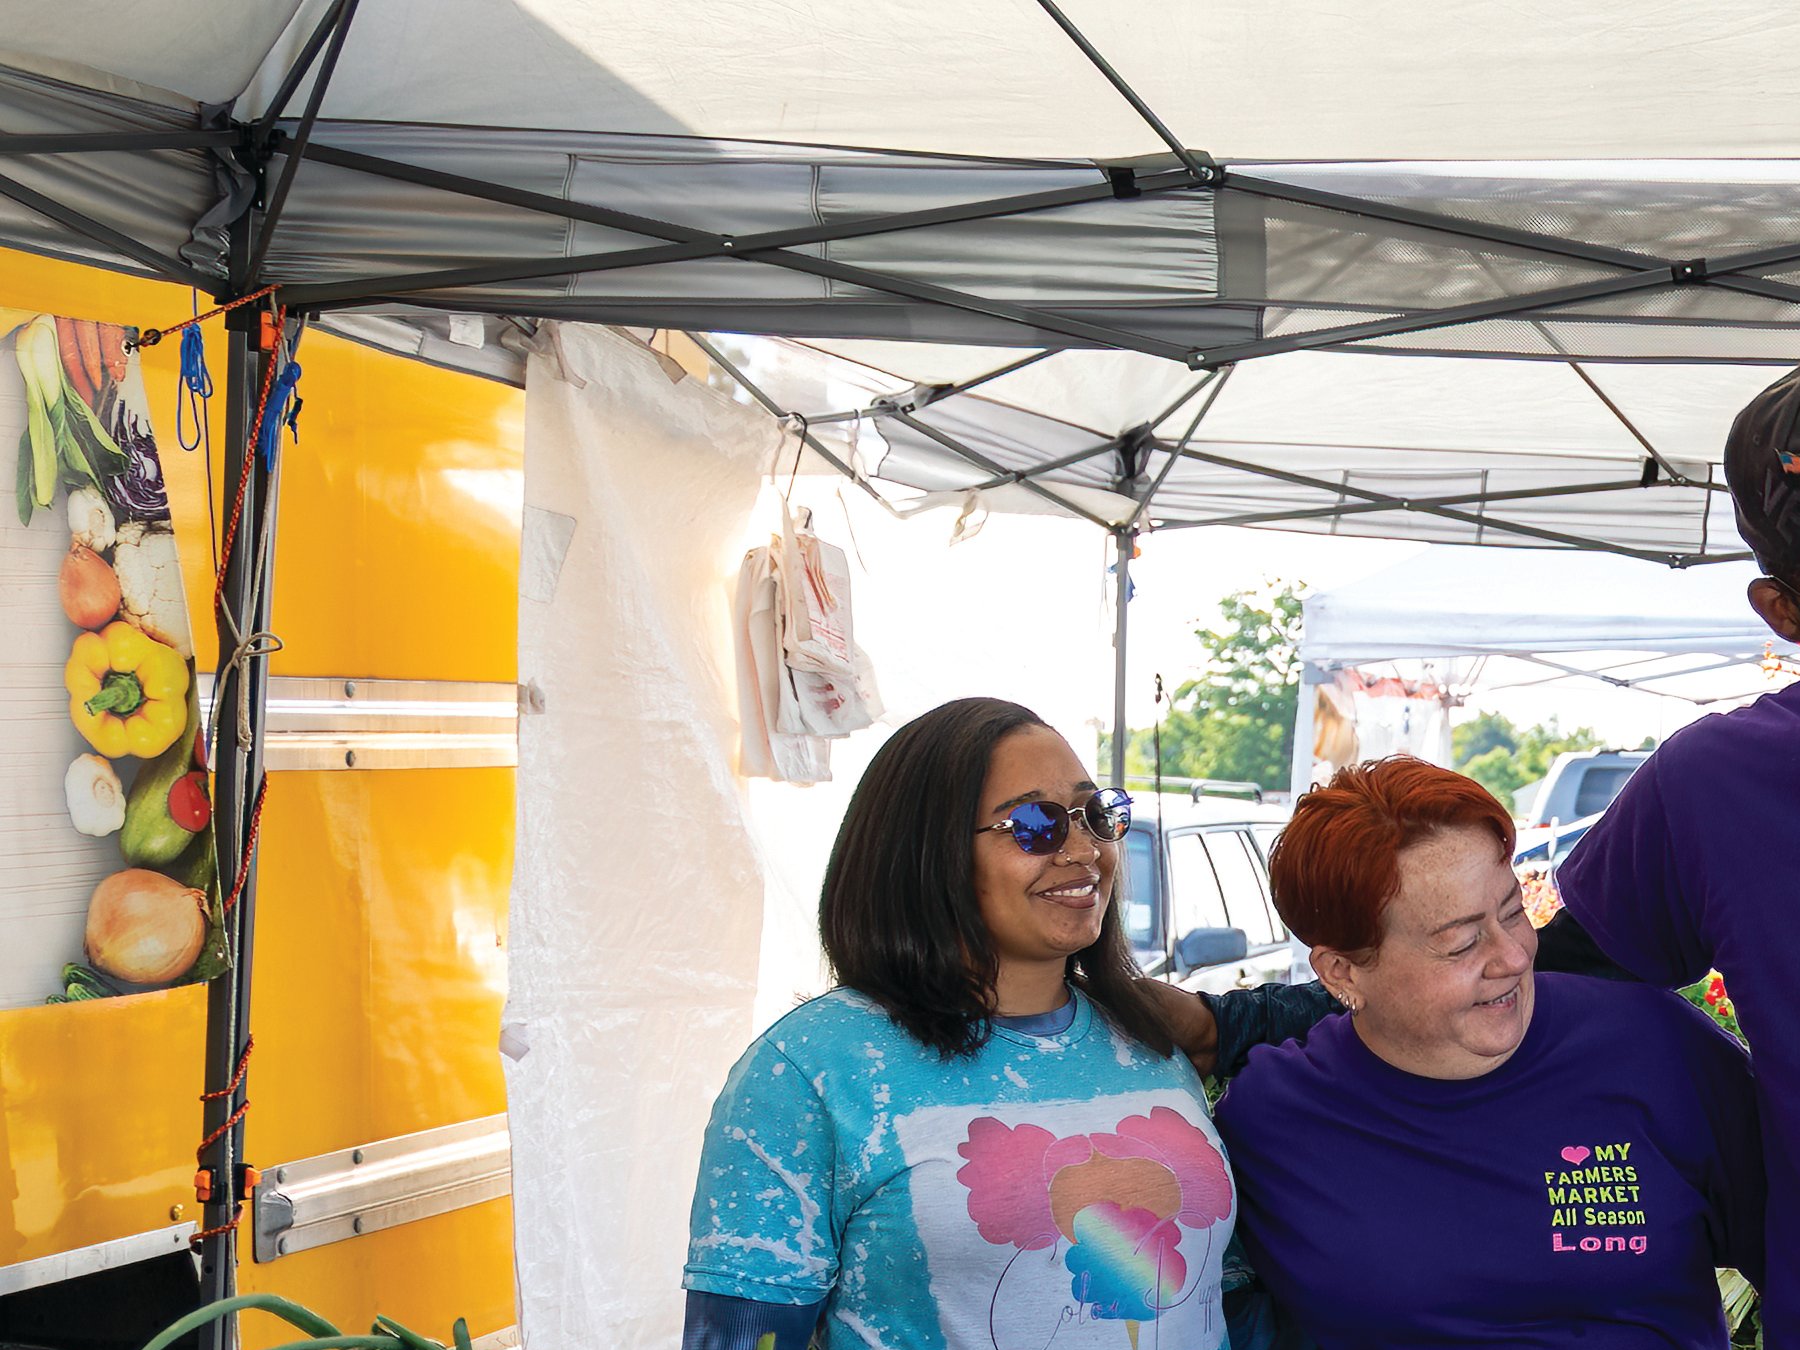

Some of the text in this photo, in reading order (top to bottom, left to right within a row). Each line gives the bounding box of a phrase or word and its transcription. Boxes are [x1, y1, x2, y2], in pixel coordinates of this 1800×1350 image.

[1594, 1142, 1631, 1162] MY
[1544, 1166, 1638, 1185] FARMERS
[1547, 1185, 1640, 1206] MARKET
[1551, 1207, 1646, 1227] All Season
[1552, 1232, 1648, 1255] Long
